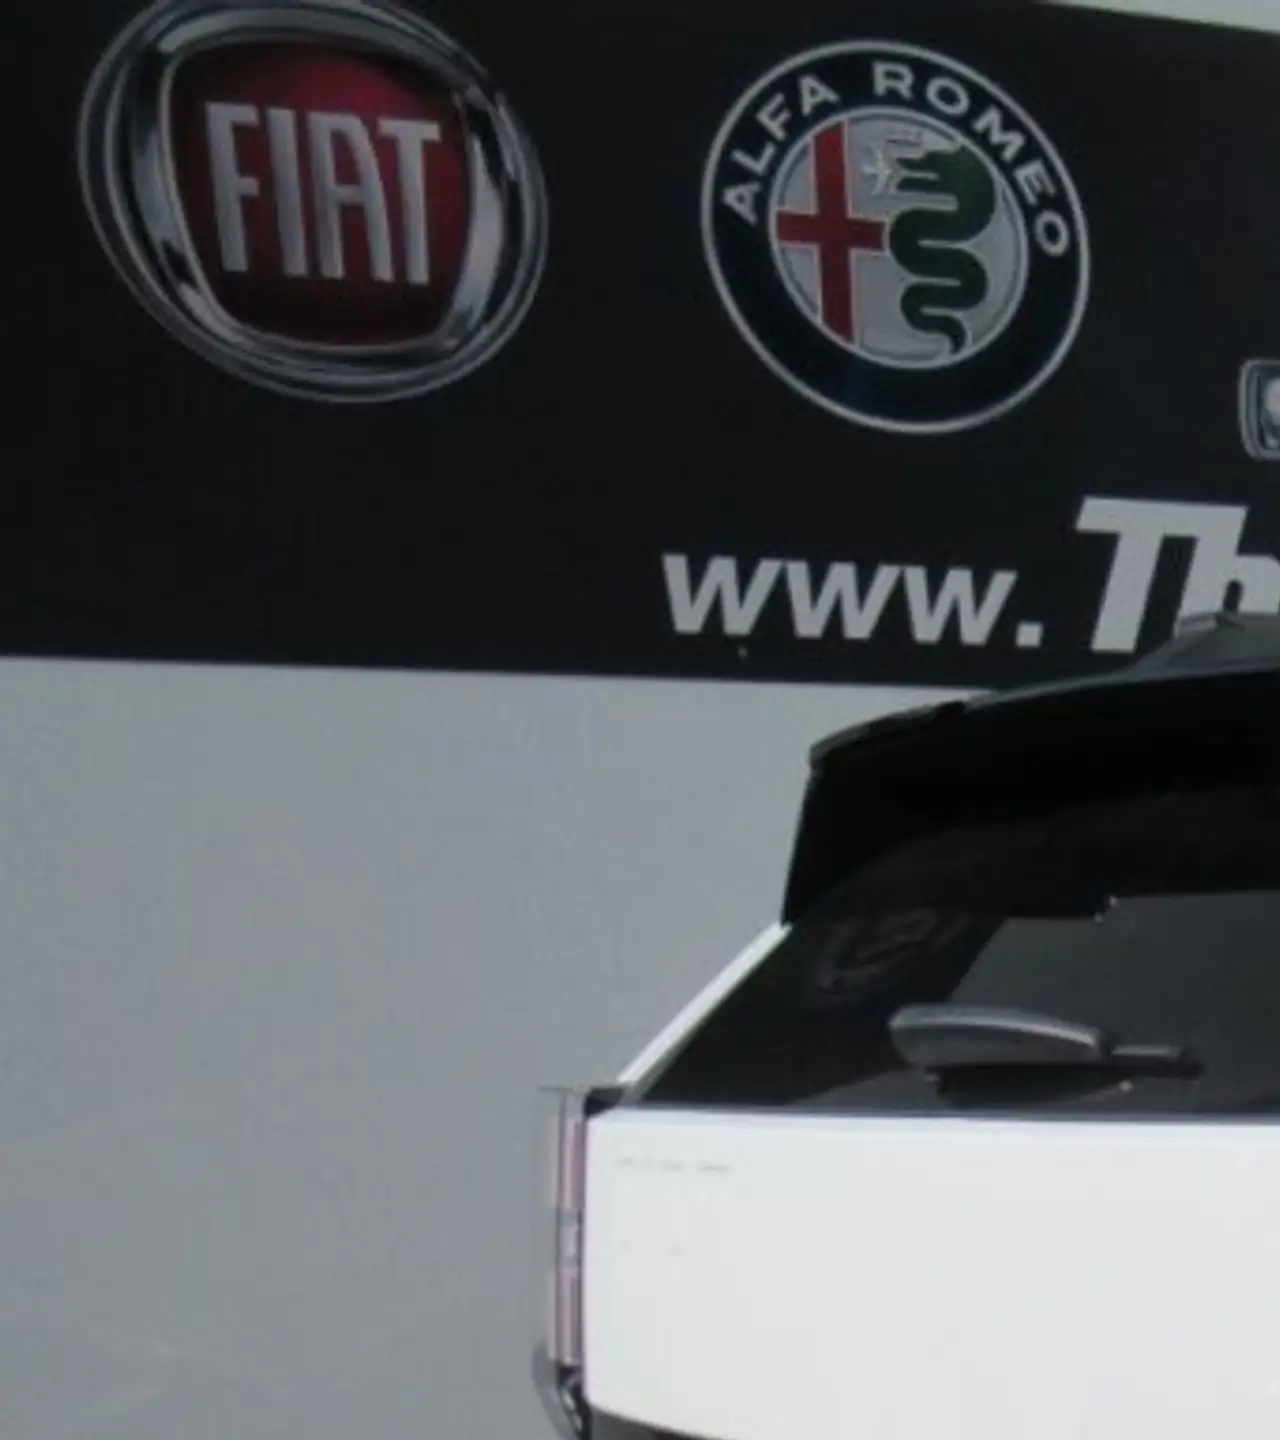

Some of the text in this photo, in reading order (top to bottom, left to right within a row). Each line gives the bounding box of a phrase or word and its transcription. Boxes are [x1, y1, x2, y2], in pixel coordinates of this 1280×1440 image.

[206, 101, 441, 286] FIAT
[722, 61, 1070, 258] ALFA ROMEO
